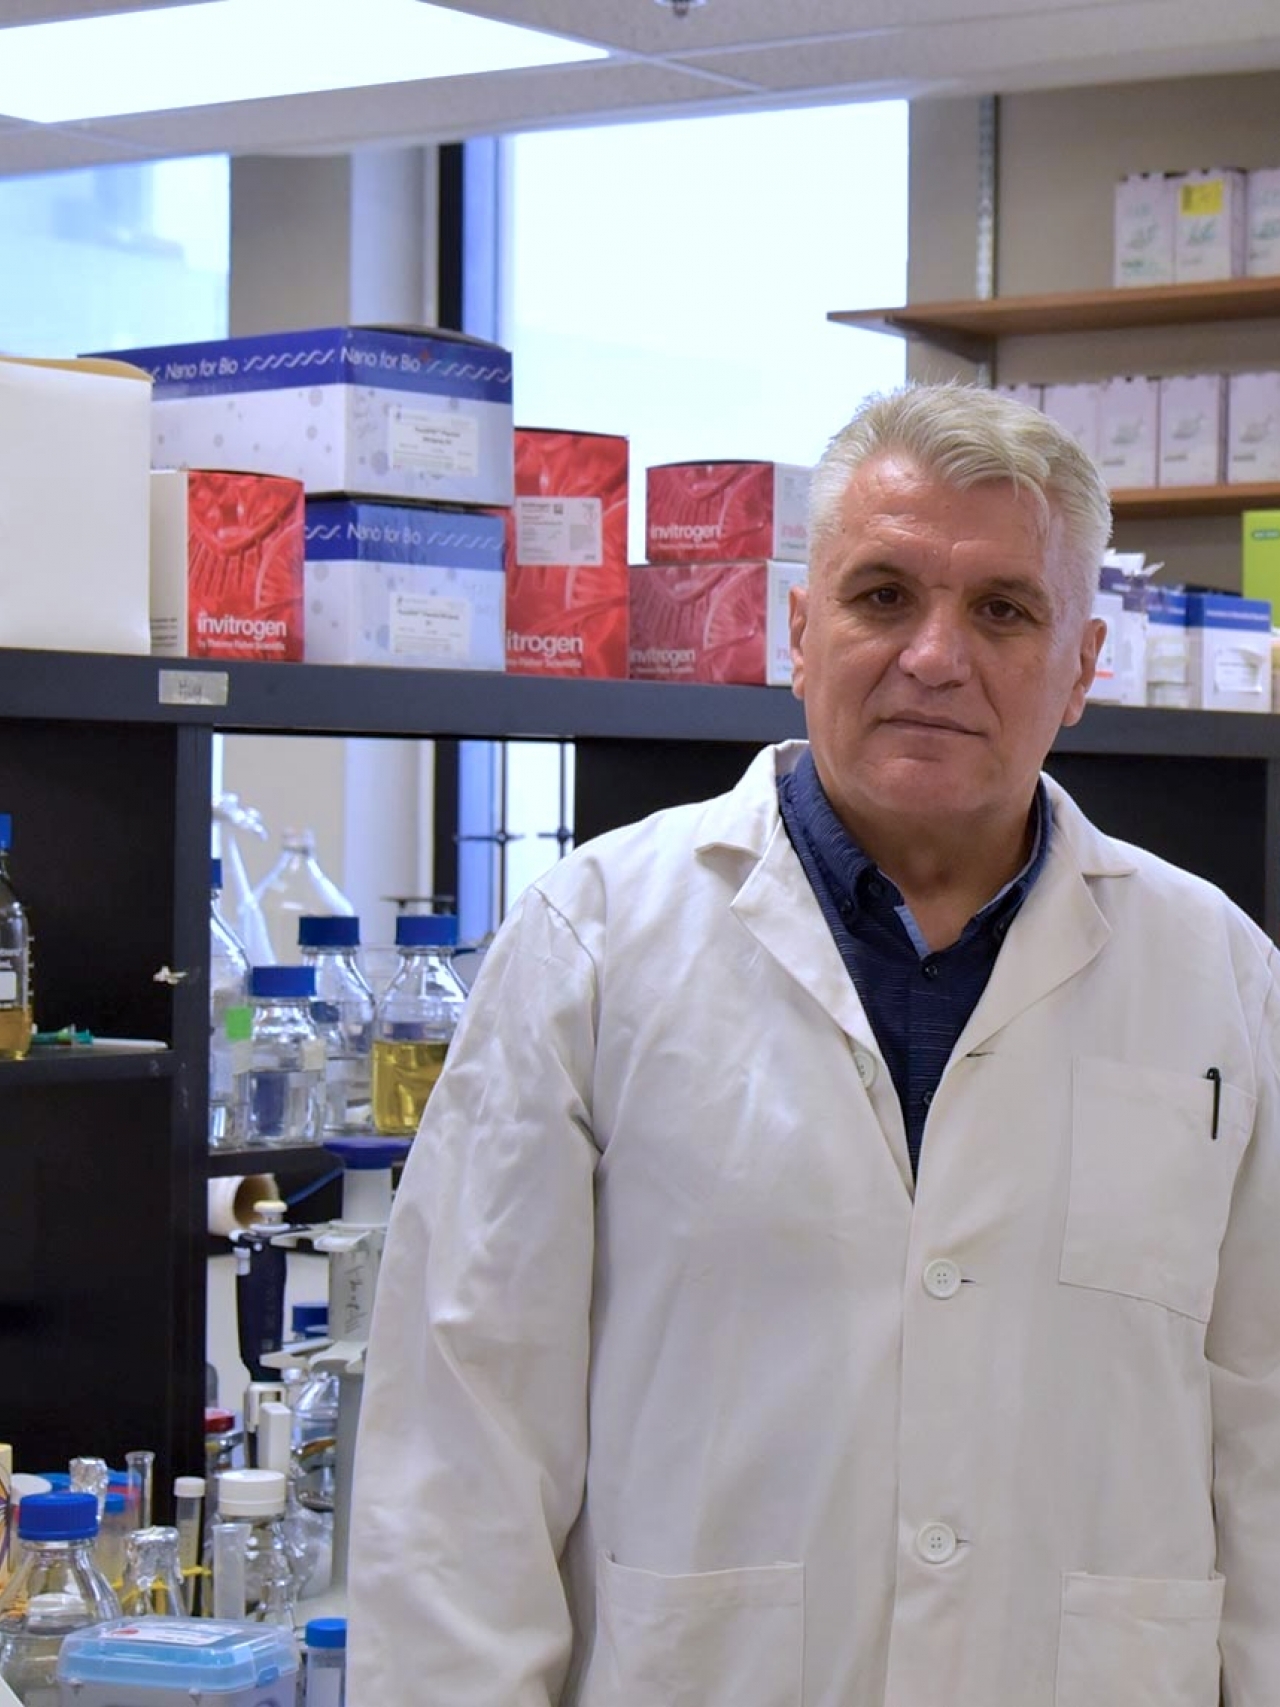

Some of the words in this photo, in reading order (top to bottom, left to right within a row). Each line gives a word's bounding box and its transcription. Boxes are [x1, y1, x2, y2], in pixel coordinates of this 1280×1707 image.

[164, 360, 197, 379] Nano
[199, 358, 216, 377] for
[218, 356, 239, 376] Bio
[340, 346, 376, 367] Nano
[381, 350, 399, 370] for
[400, 353, 421, 372] Bio
[346, 521, 381, 542] Nano
[383, 524, 400, 543] for
[402, 526, 421, 545] Bio
[650, 522, 722, 542] invitrogen
[197, 608, 287, 641] invitrogen
[506, 629, 584, 658] itrogen
